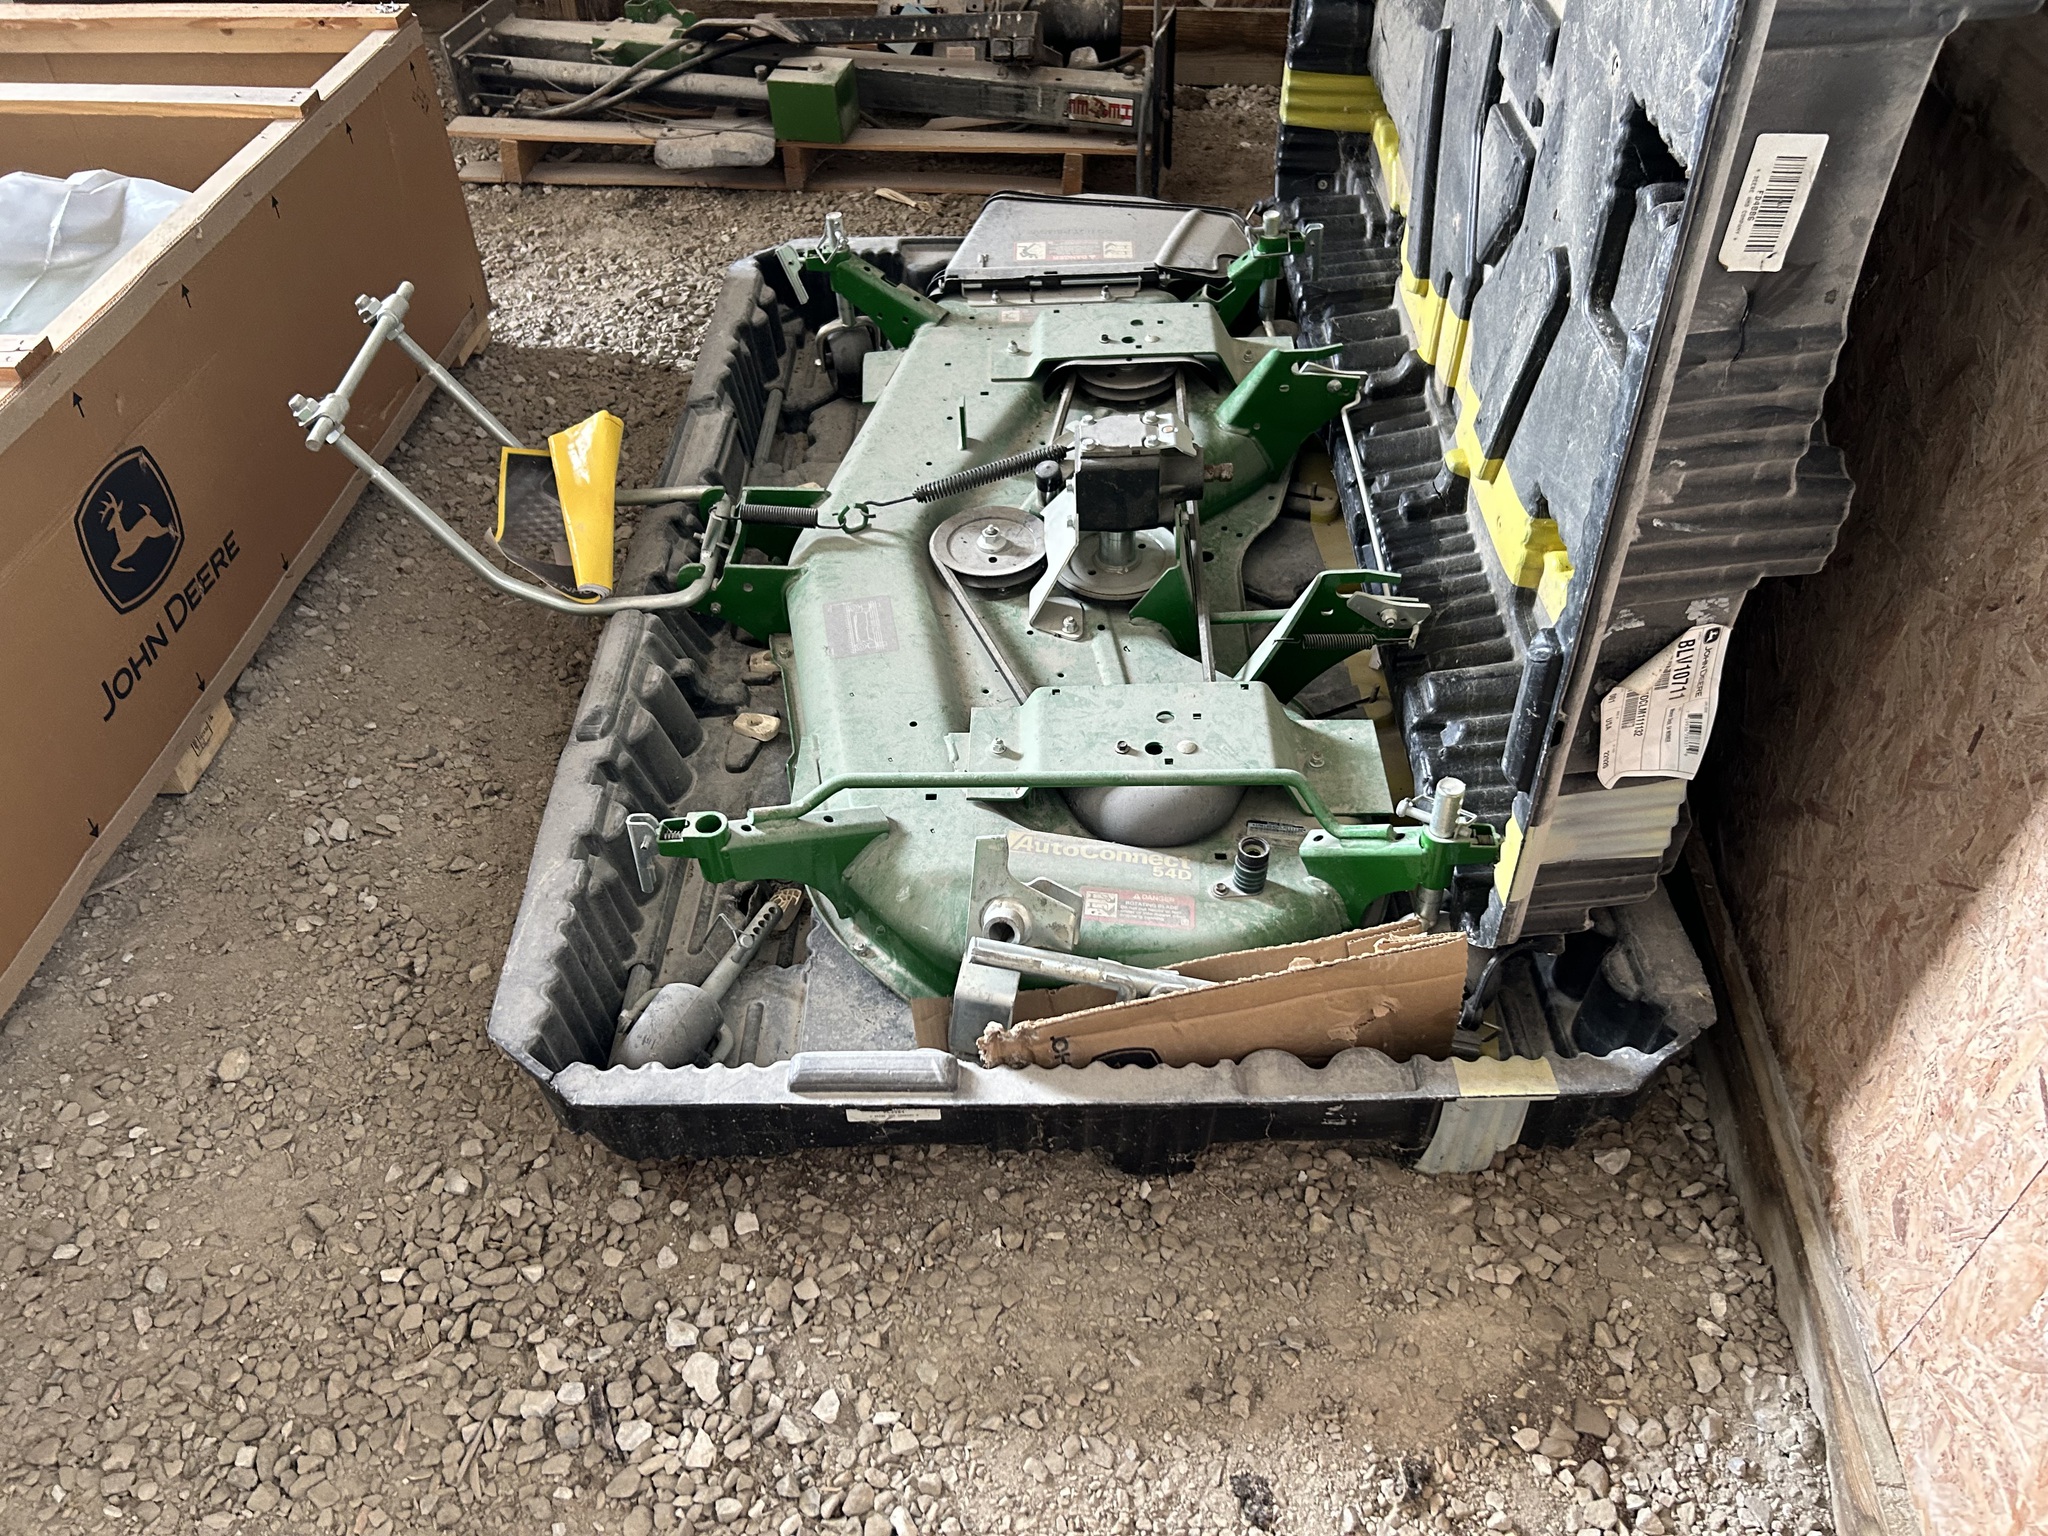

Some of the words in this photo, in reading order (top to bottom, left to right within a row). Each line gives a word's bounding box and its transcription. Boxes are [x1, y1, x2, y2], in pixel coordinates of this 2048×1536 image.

[101, 621, 169, 722] JOHN
[163, 529, 241, 633] DEERE
[1668, 638, 1696, 700] BLV10711
[1700, 646, 1710, 670] JOHN
[1694, 669, 1708, 698] DEERE
[1014, 834, 1192, 870] AutoConnect
[1152, 866, 1192, 881] 54D
[1141, 893, 1175, 903] DANGER
